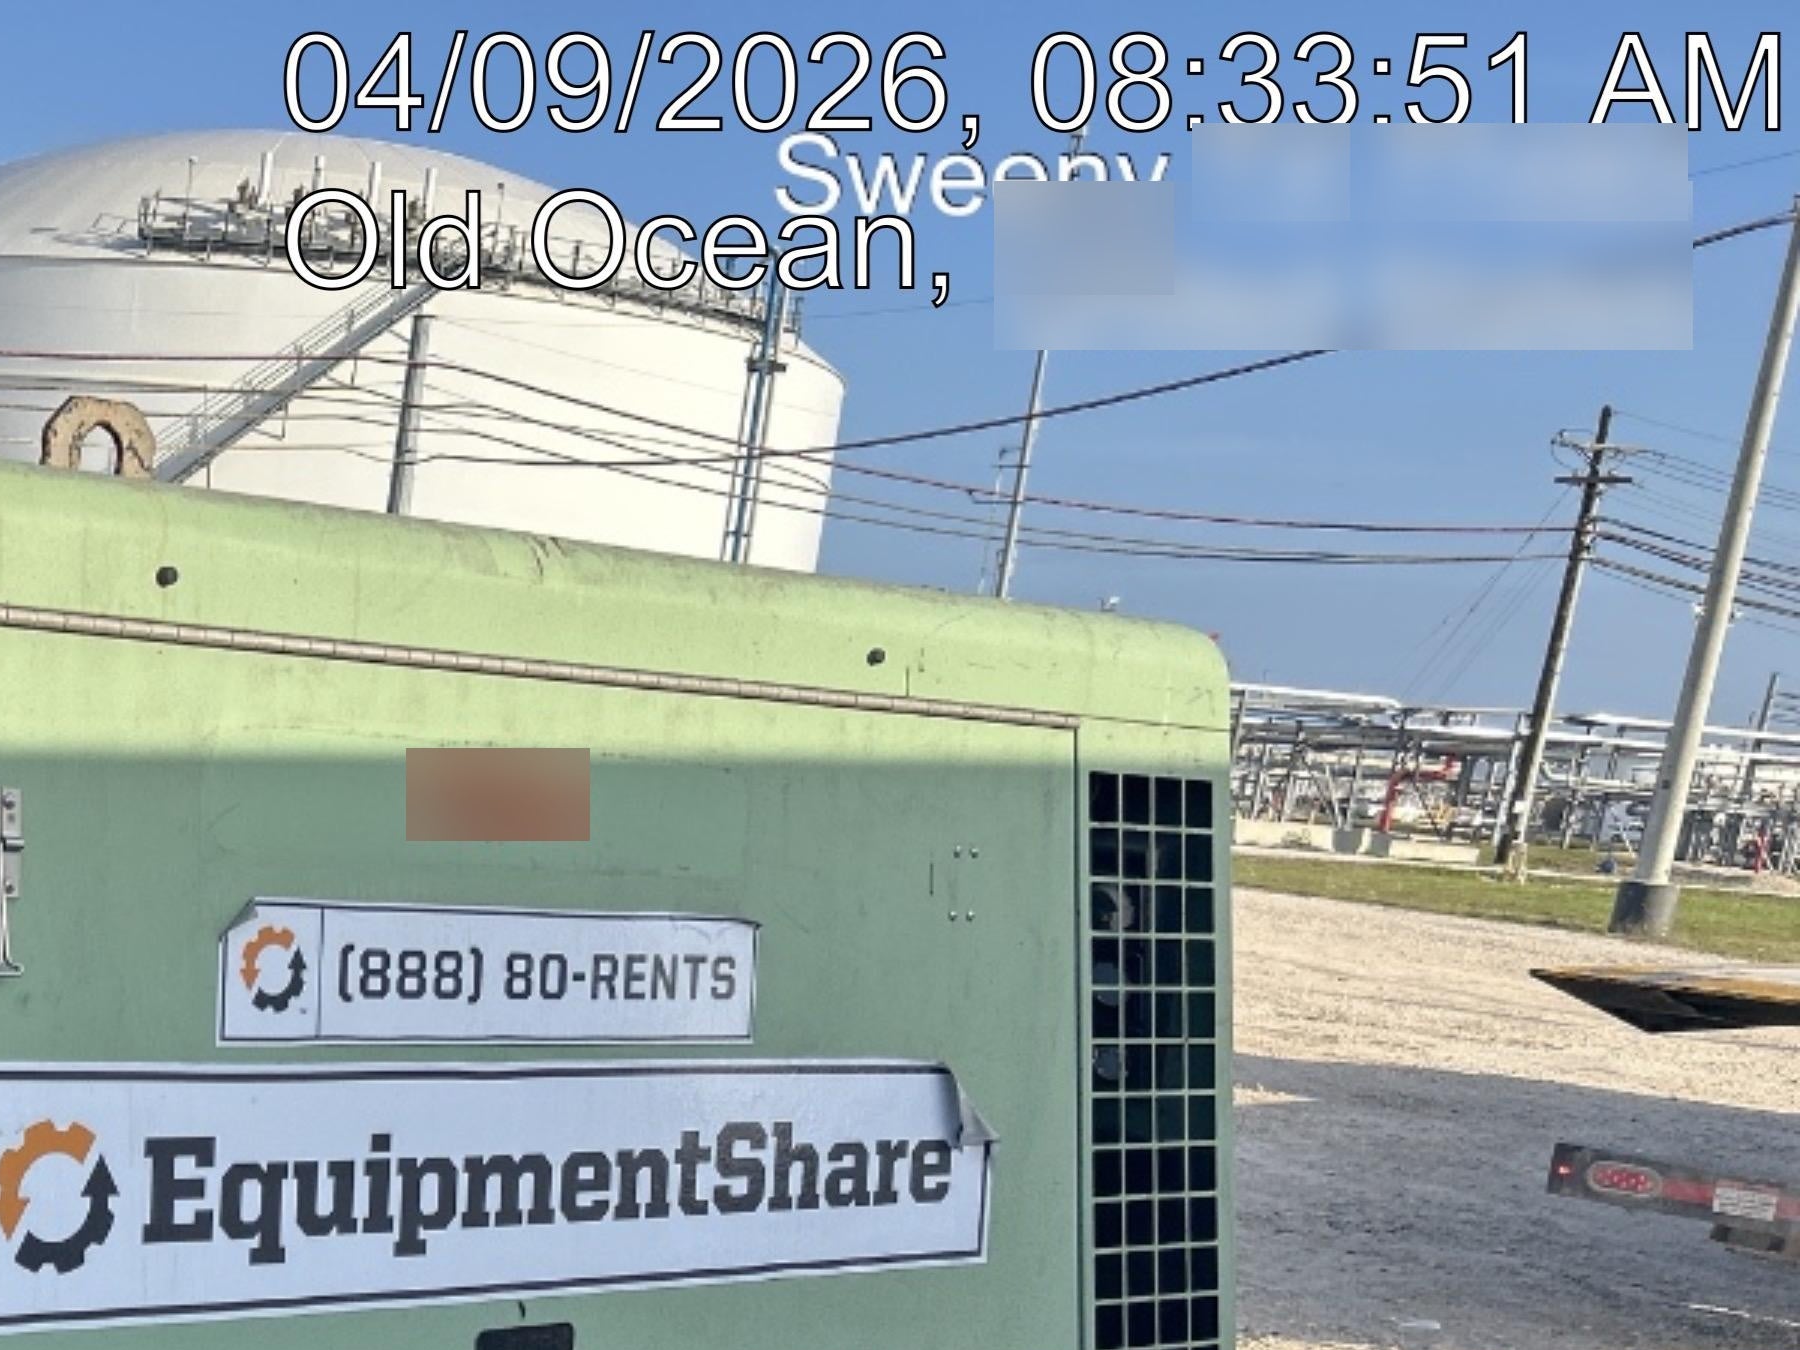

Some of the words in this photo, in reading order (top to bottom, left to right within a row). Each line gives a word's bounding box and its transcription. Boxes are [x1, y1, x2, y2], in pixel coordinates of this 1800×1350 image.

[338, 944, 484, 1003] (888)
[504, 952, 737, 1001] 80-RENTS
[142, 1121, 952, 1265] EquipmentShare
